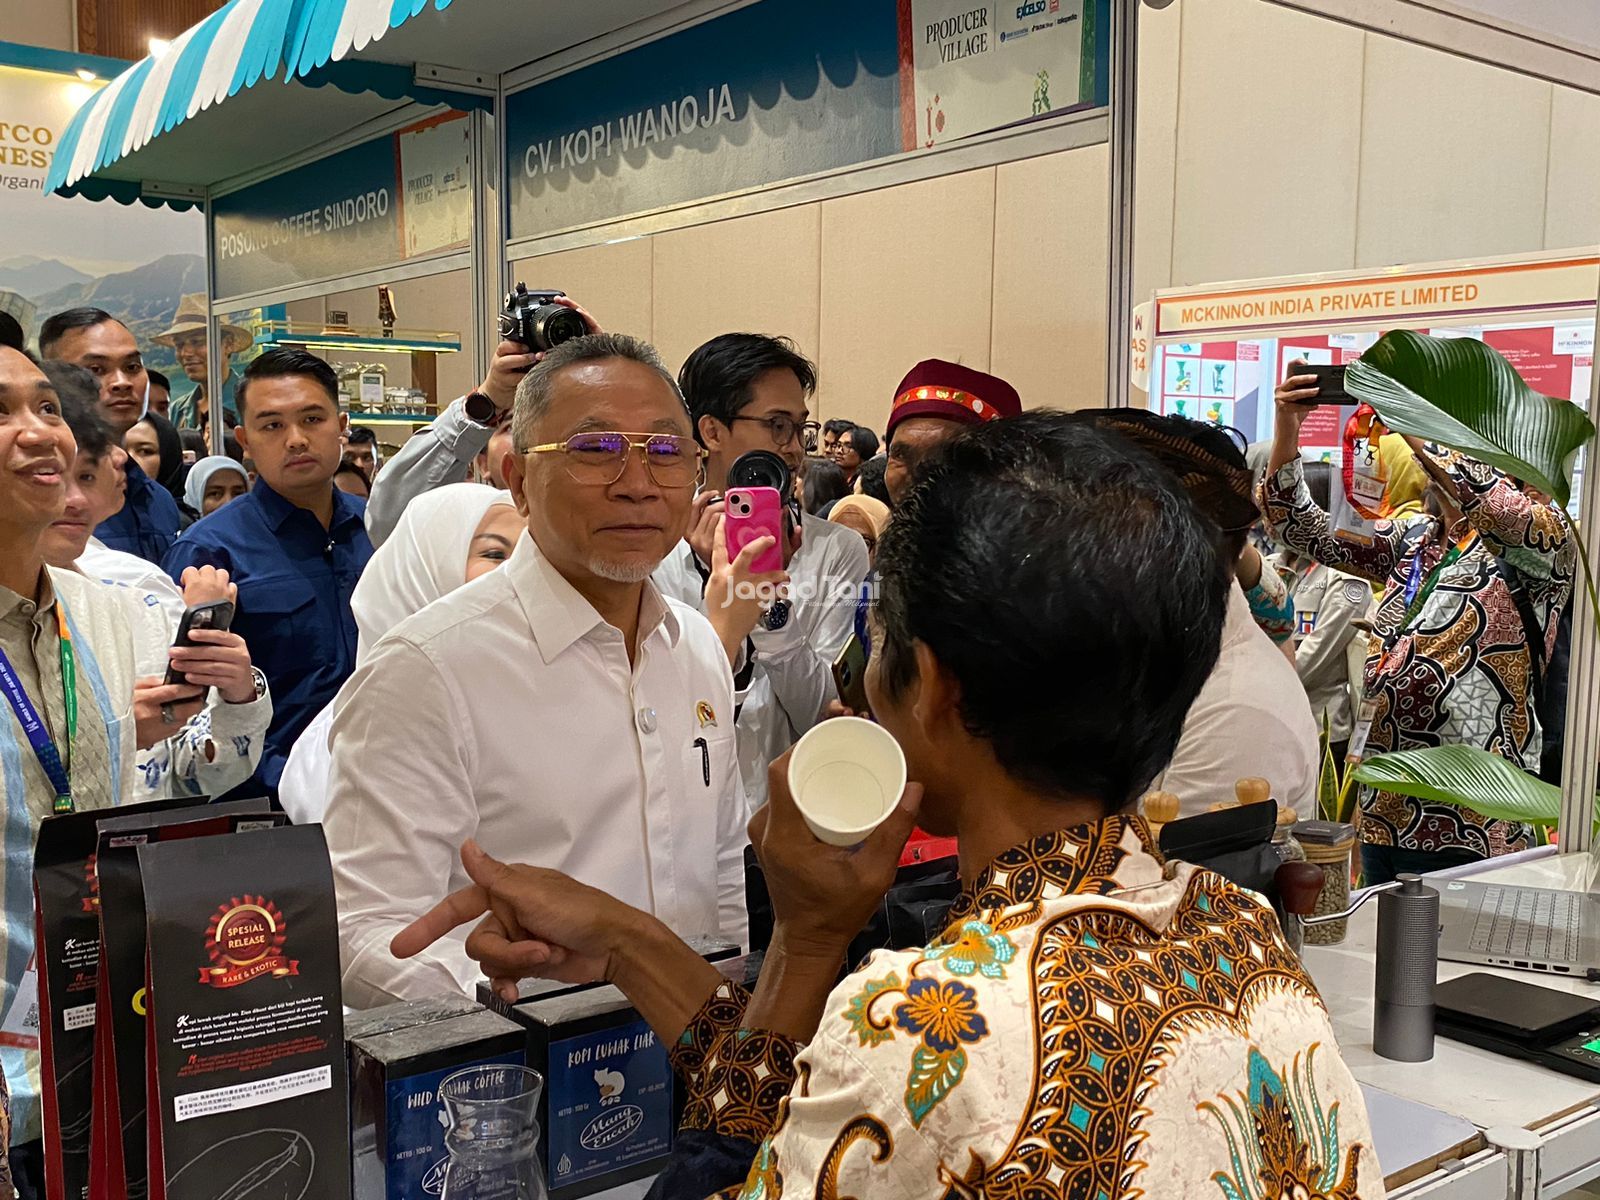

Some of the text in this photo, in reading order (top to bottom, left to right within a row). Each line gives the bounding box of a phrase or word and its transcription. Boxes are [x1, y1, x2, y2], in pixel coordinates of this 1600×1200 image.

[926, 8, 988, 44] PRODUCER
[938, 32, 988, 63] VILLAGE
[525, 83, 736, 178] CV. KOPI WANOJA
[271, 208, 321, 246] COFFEE
[324, 188, 389, 232] SINDORO
[1181, 284, 1479, 323] MCKINNON INDIA PRIVATE LIMITED
[1133, 357, 1146, 371] 14
[227, 923, 265, 937] SPESIAL
[228, 935, 265, 949] RELEASE
[222, 972, 242, 984] RARE
[250, 960, 278, 976] EXOTIC
[568, 1030, 655, 1068] KOPI LUWAK LIAR
[407, 1092, 433, 1109] WILD
[474, 1070, 505, 1090] COFFEE
[590, 1107, 632, 1134] Mang
